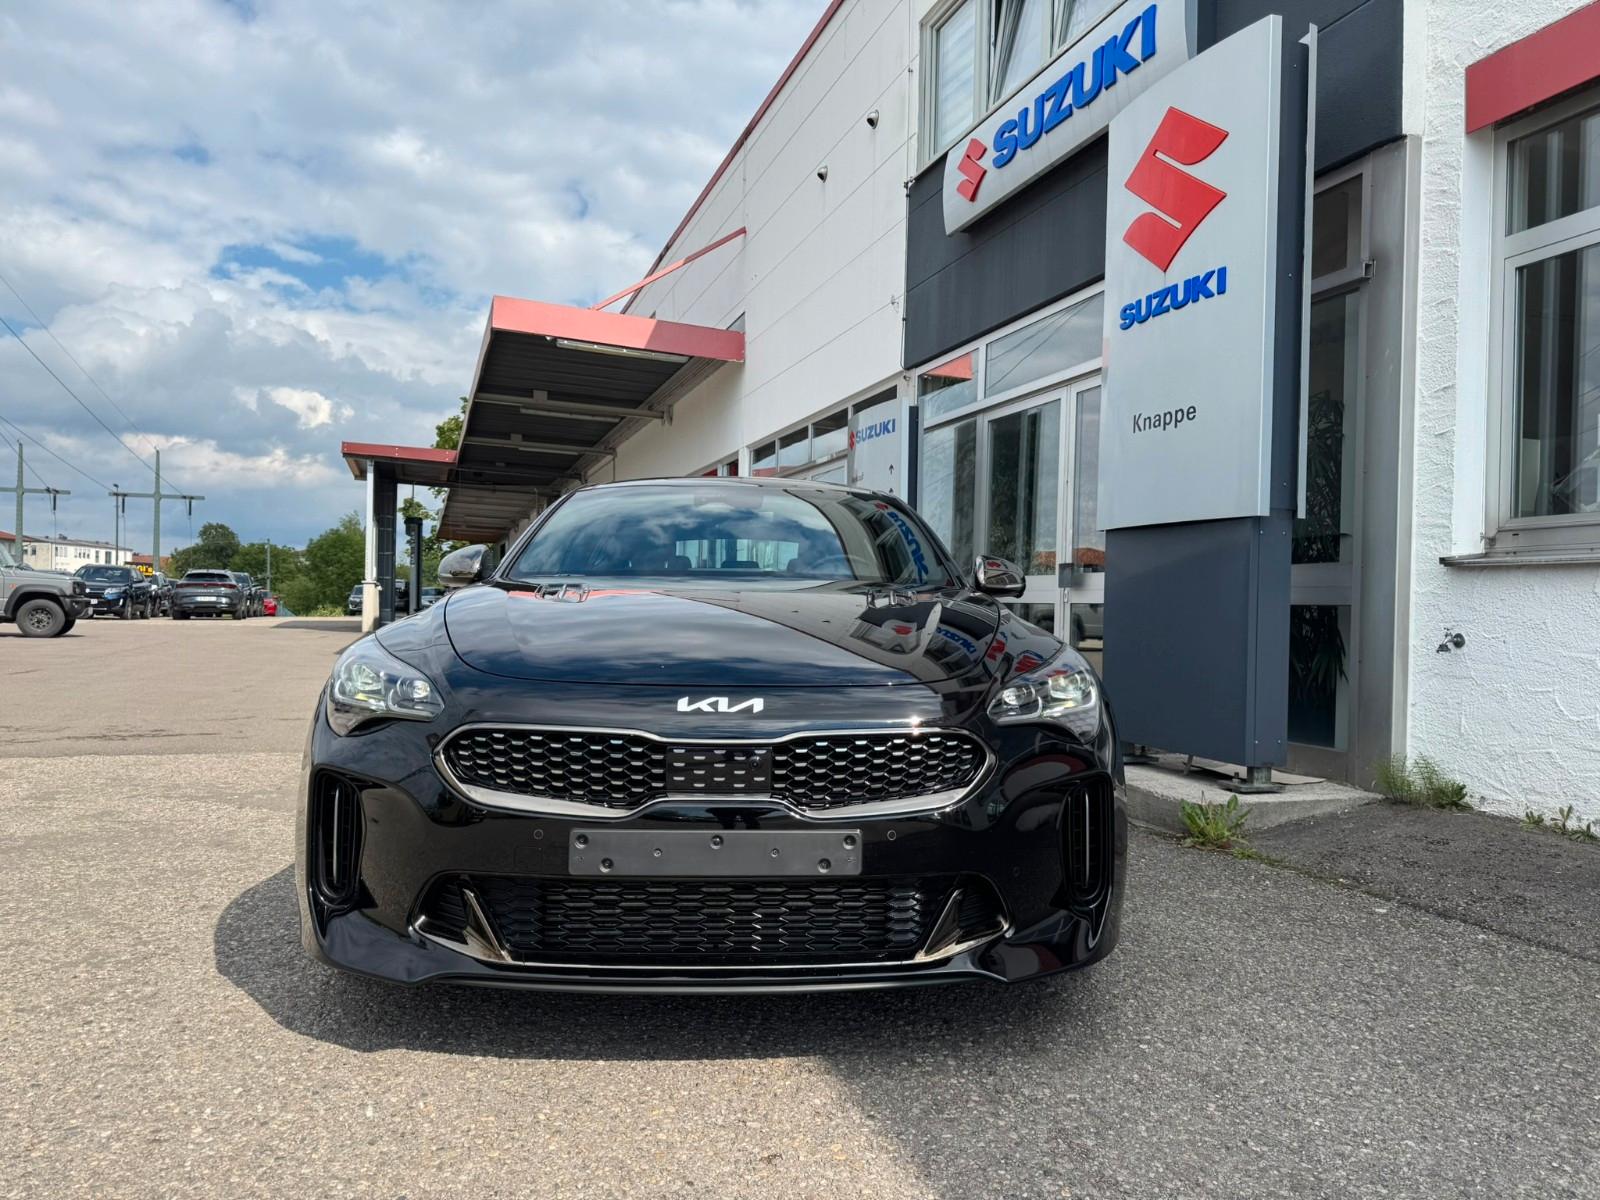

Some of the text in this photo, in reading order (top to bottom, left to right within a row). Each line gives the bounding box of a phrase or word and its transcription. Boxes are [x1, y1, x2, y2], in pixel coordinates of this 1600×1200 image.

[992, 4, 1157, 168] SUZUKI
[1119, 266, 1227, 331] SUZUKI
[855, 418, 896, 444] SUZUKI
[1132, 405, 1197, 433] Knappe
[676, 696, 764, 714] KIA
